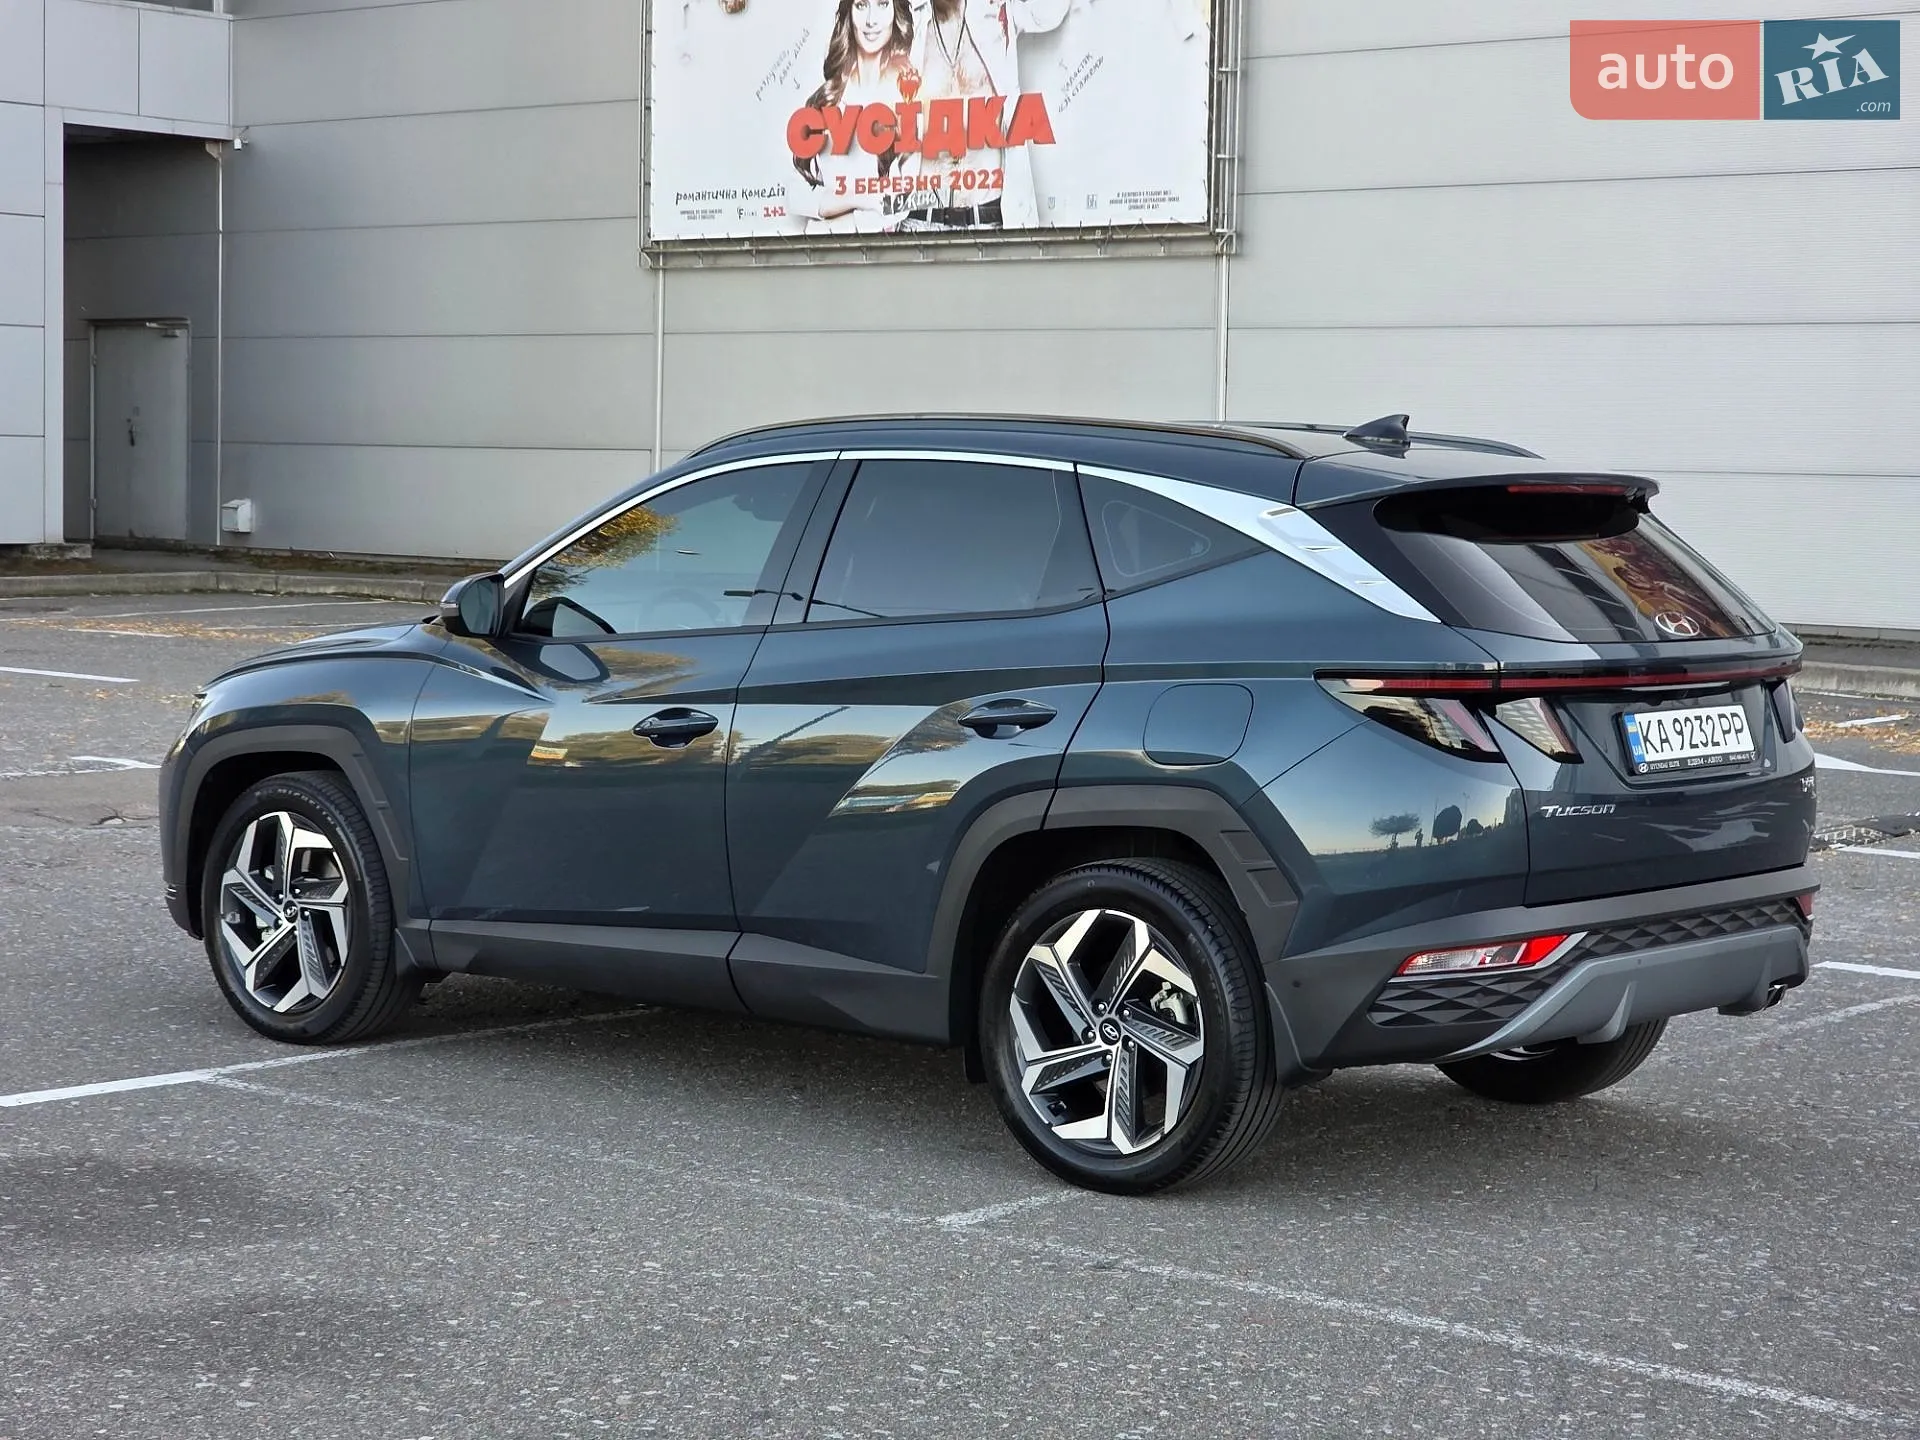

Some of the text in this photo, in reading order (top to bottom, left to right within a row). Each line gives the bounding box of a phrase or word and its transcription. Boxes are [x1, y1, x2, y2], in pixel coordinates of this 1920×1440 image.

[787, 93, 1056, 159] СУСІДКА
[835, 168, 1004, 196] 3 БЕРЕЗНЯ 2022
[763, 206, 787, 218] 1+1
[1673, 715, 1720, 750] 9232
